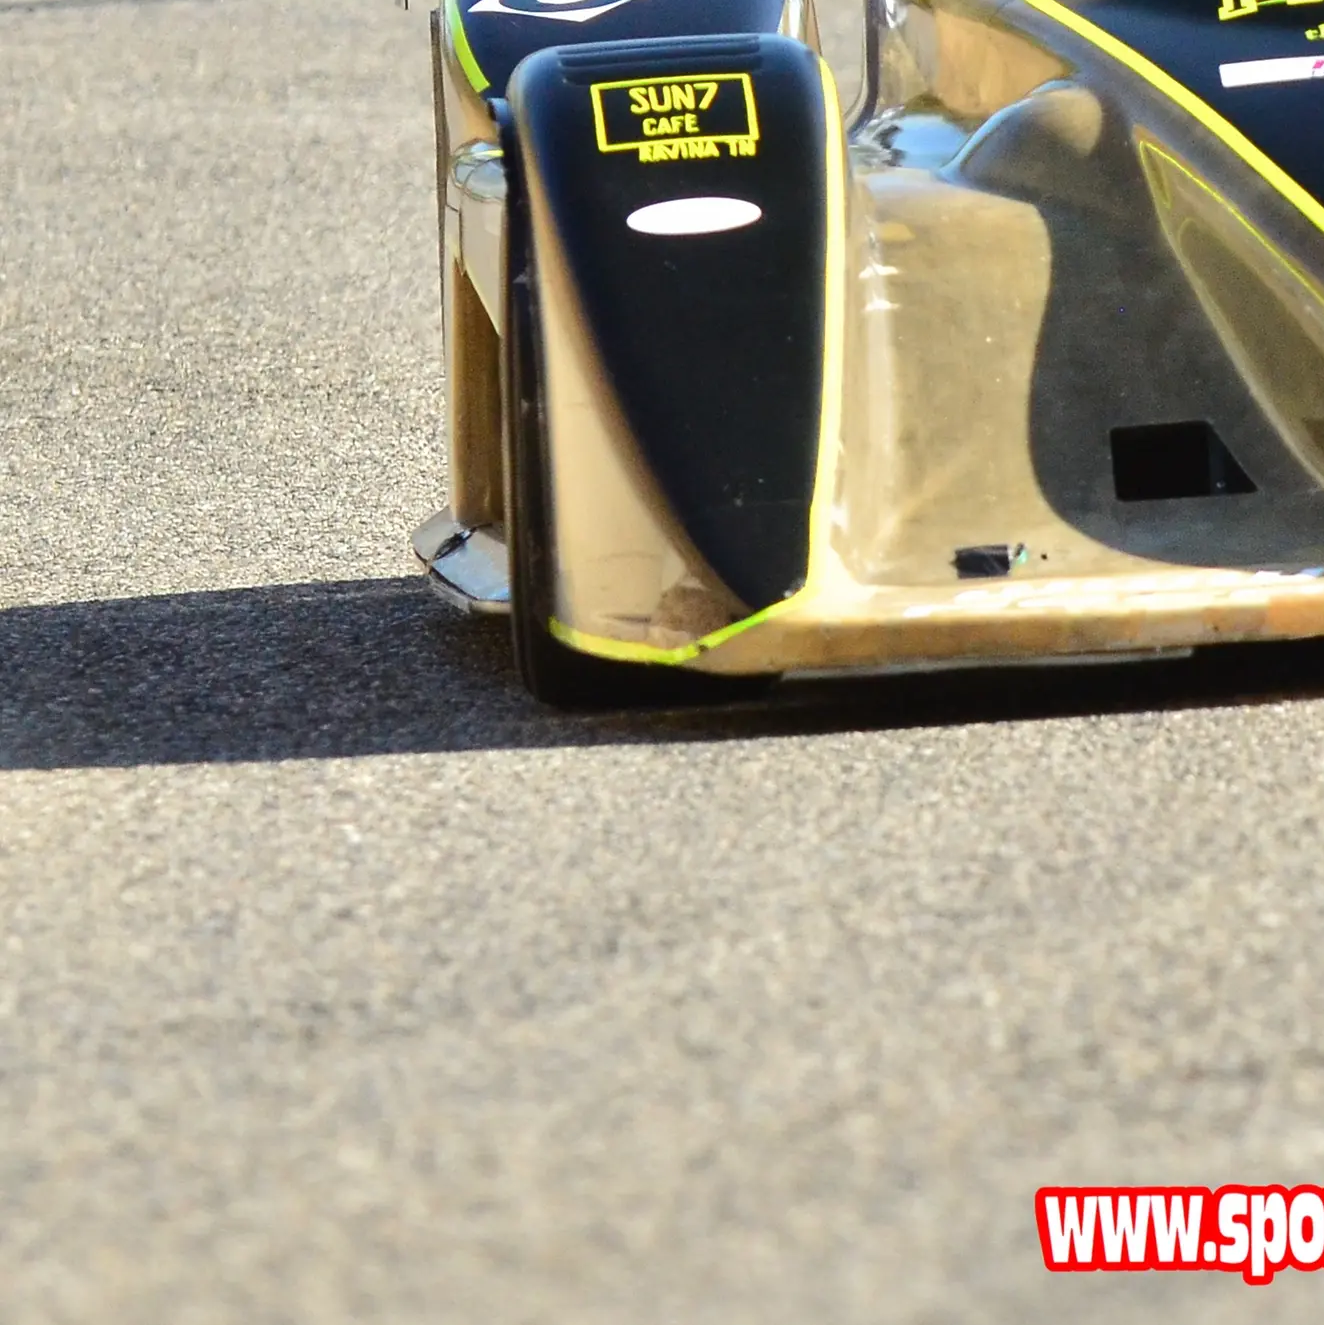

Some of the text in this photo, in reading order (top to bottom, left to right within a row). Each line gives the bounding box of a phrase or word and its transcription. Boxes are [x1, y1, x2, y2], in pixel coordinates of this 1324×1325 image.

[628, 81, 718, 114] SUN7
[638, 139, 757, 163] RAVINA TN
